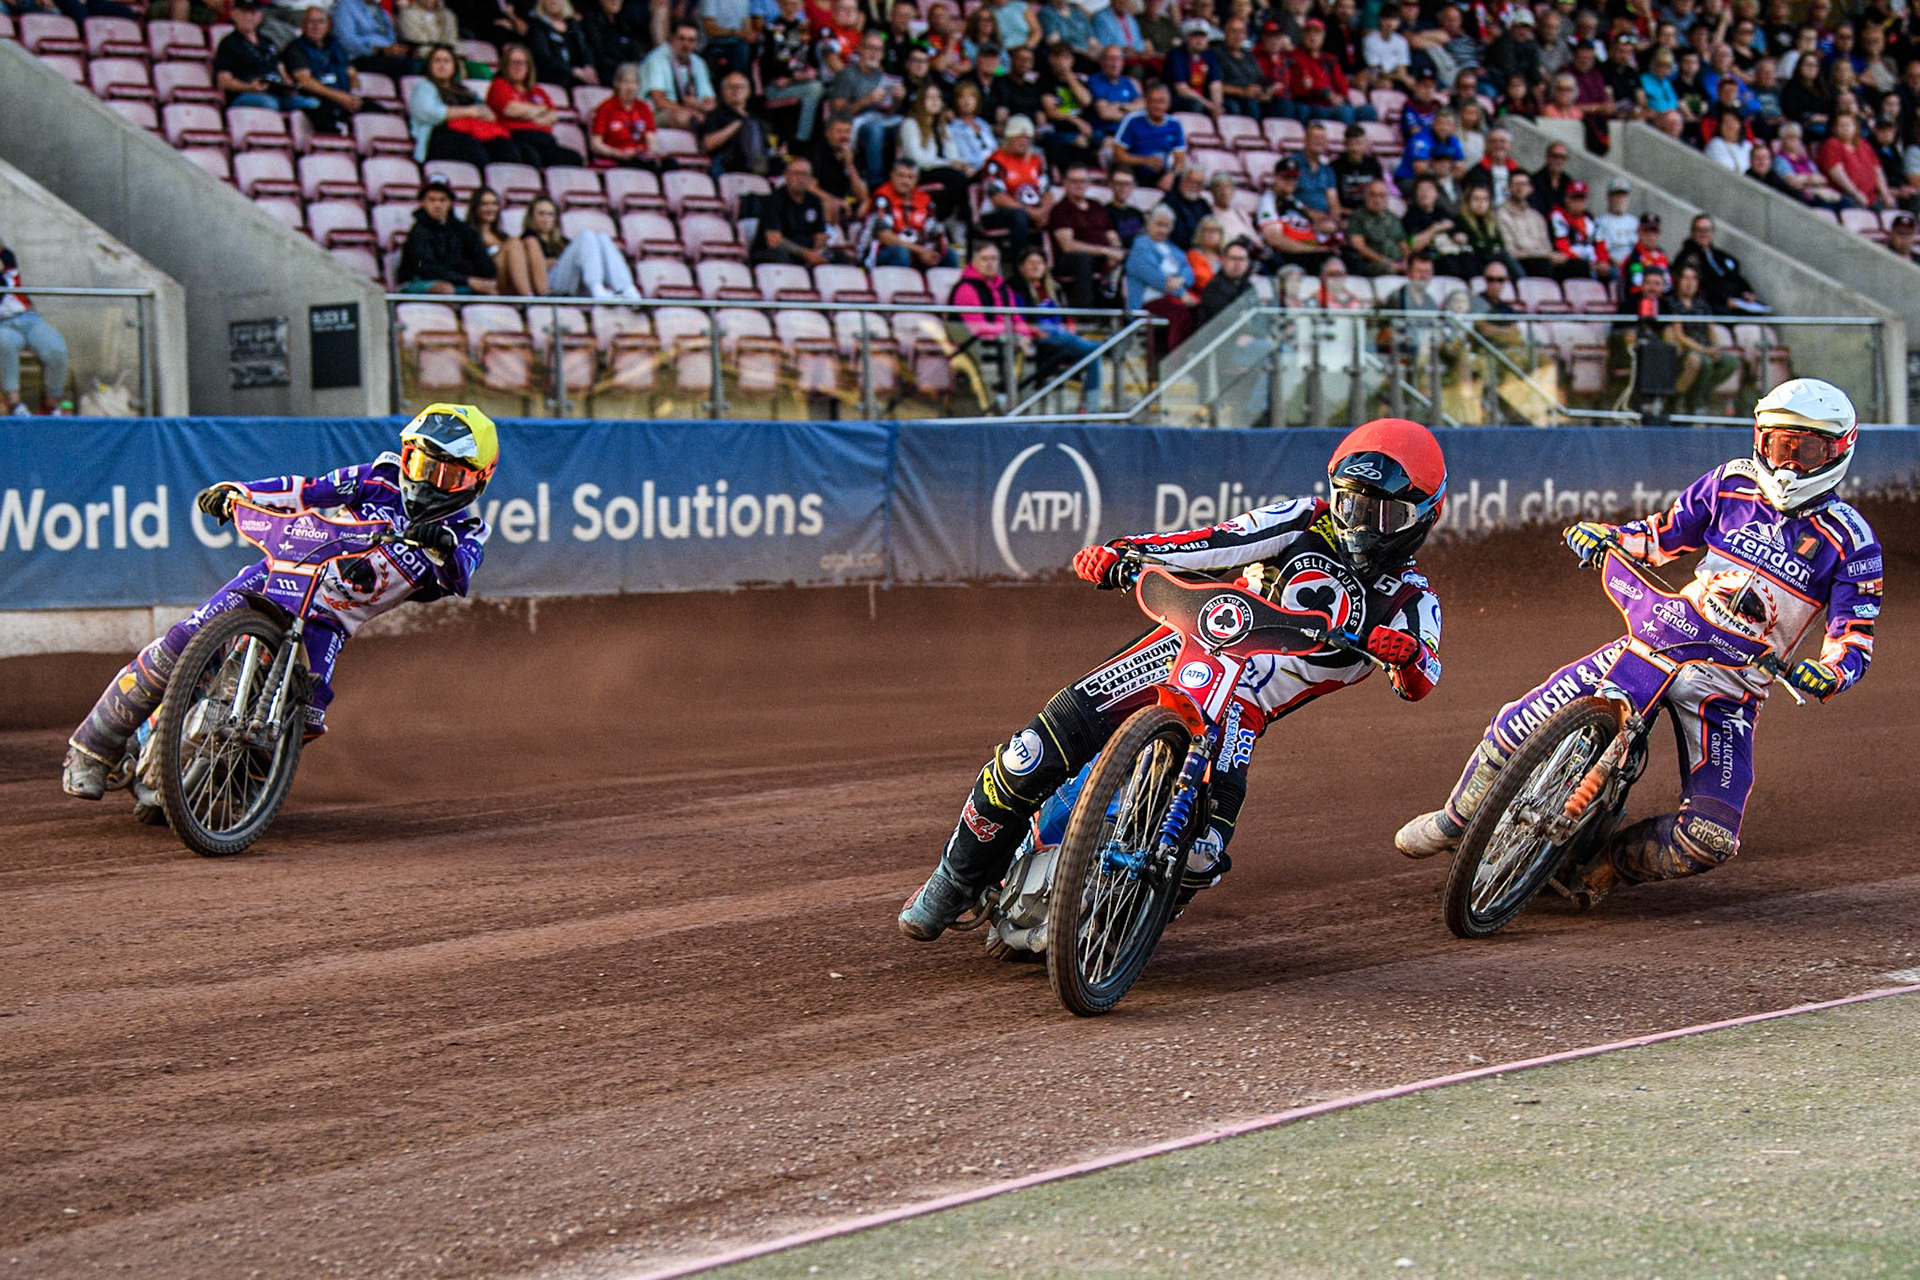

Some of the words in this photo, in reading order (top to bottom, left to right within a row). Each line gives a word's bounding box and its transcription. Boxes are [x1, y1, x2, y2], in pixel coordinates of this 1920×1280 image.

[0, 484, 169, 551] World
[573, 479, 825, 542] Solutions
[1010, 491, 1081, 532] ATPI
[283, 524, 329, 540] Crendon
[1797, 536, 1817, 555] 1
[1380, 577, 1398, 593] 5
[1730, 545, 1758, 563] TIMBER
[1757, 558, 1808, 592] ENGINEERING
[1205, 597, 1225, 612] BELLE
[1227, 597, 1241, 607] VUE
[1294, 557, 1332, 571] BELLE
[1336, 570, 1357, 593] VUE
[1350, 594, 1362, 628] ACES
[1651, 602, 1699, 637] Crendon
[1103, 657, 1172, 692] FLOORIN
[1184, 669, 1207, 681] ATPI
[1507, 674, 1582, 742] HANSEN
[1576, 664, 1599, 686] &
[1013, 738, 1032, 765] ATPI
[1711, 732, 1722, 767] GROUP
[1720, 741, 1734, 790] AUCTION
